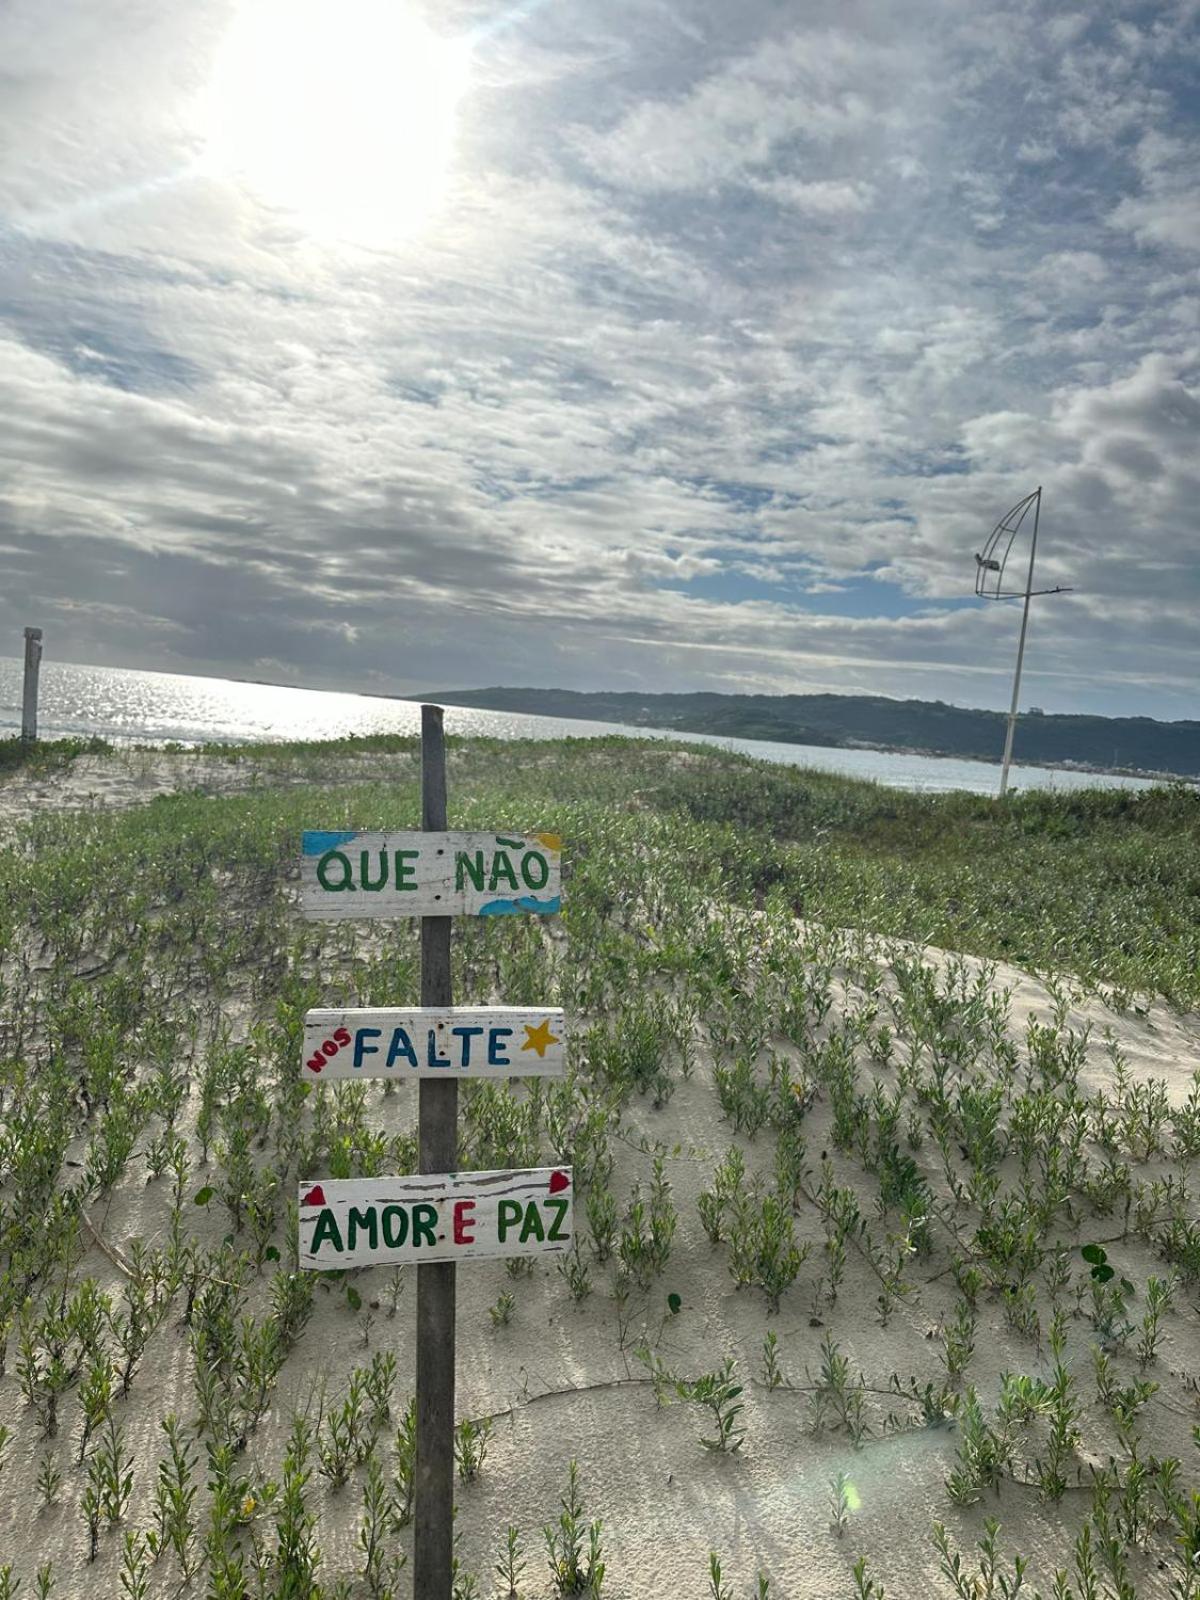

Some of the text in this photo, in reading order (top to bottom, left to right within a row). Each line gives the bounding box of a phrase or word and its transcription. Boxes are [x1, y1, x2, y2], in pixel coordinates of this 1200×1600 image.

[316, 835, 549, 892] QUE NÃO
[306, 1027, 513, 1073] NOS FALTE
[310, 1199, 570, 1254] AMOR E PAZ
